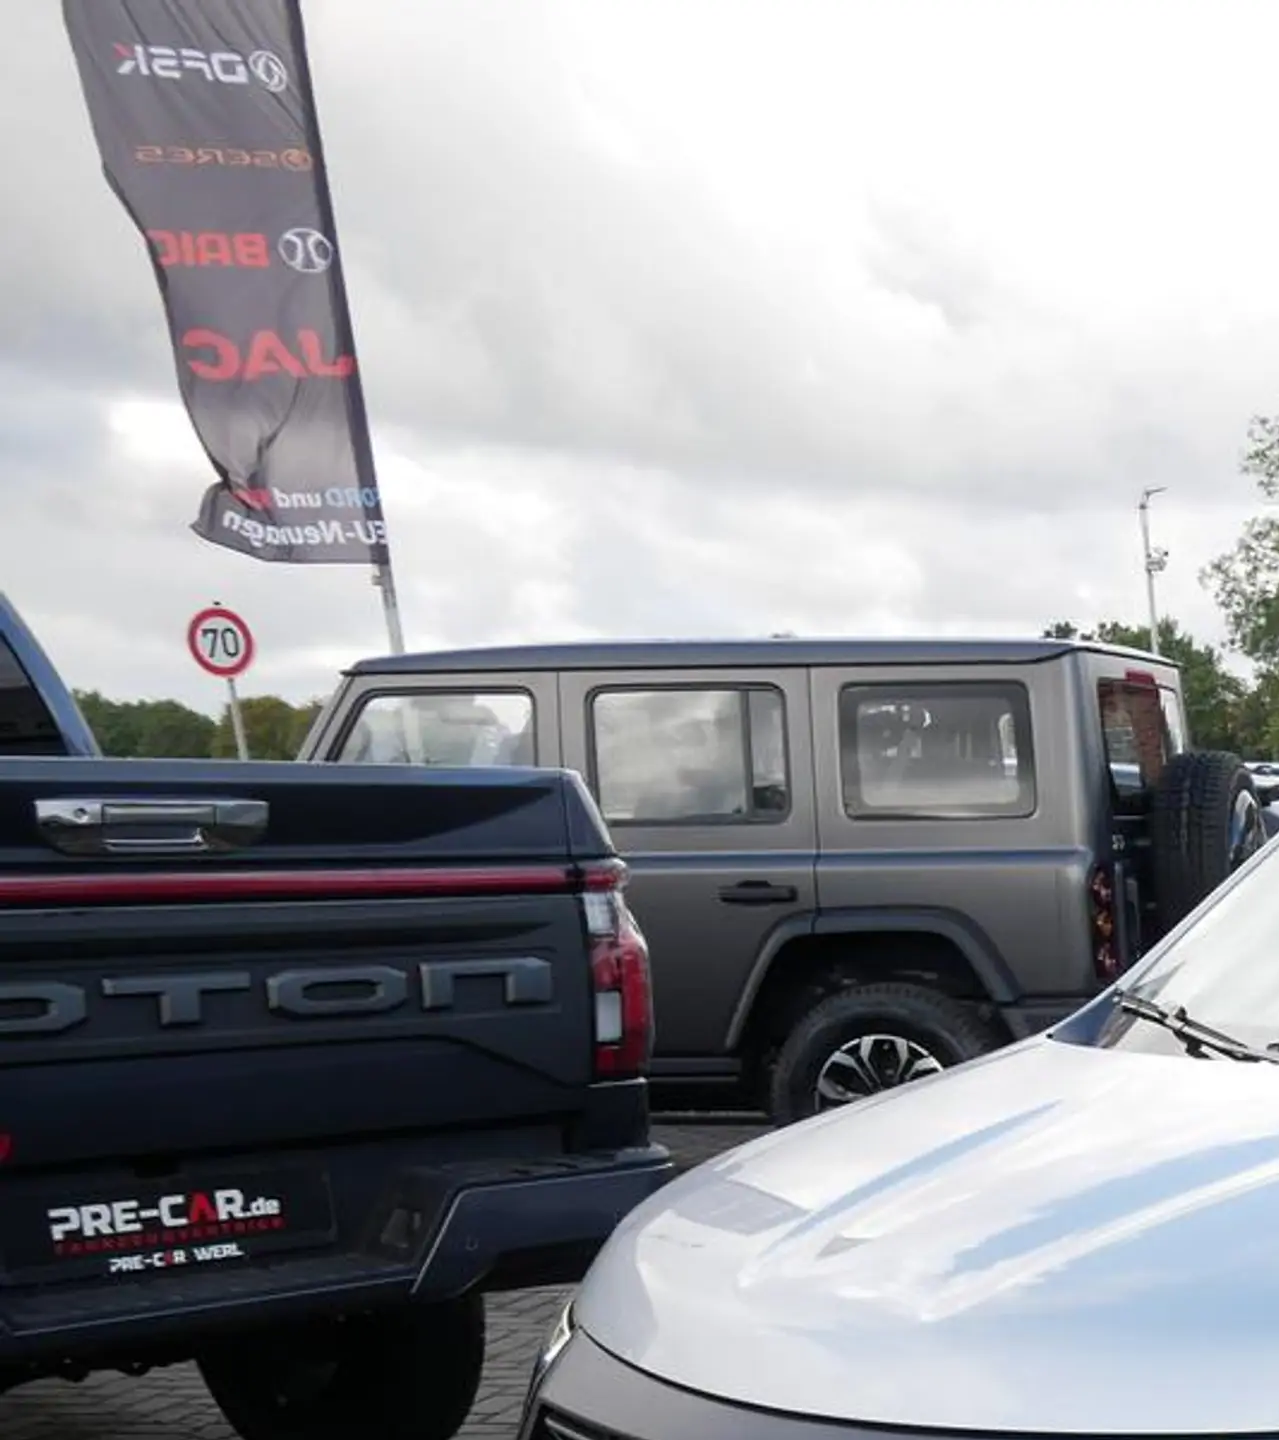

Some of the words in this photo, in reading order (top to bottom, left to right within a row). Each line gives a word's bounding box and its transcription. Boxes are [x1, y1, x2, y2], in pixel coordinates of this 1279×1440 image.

[202, 627, 240, 658] 70
[48, 1189, 281, 1241] PRE-CAR.de
[109, 1249, 187, 1272] PRE-CAR
[193, 1242, 245, 1261] WERL
